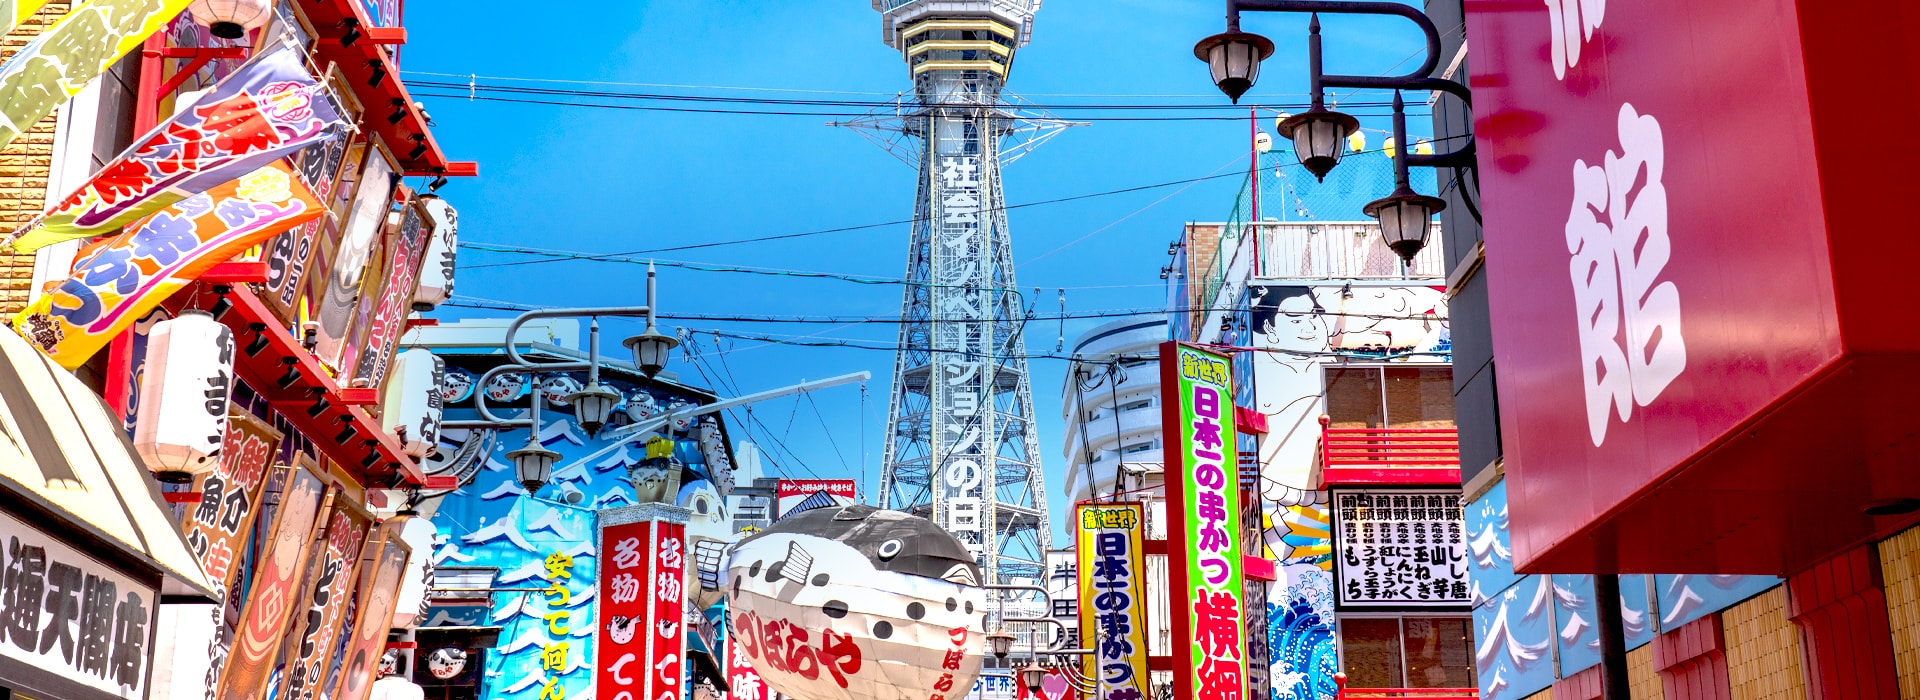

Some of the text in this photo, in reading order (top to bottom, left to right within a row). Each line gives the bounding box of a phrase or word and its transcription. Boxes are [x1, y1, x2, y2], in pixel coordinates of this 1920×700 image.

[1182, 352, 1228, 388] 新世界
[1192, 385, 1230, 584] 日本一の串かつ
[1341, 494, 1357, 521] 前頭
[1376, 494, 1392, 521] 前頭
[1393, 494, 1409, 521] 前頭
[1410, 494, 1426, 521] 前頭
[1427, 494, 1443, 521] 前頭
[1444, 494, 1460, 521] 前頭
[1083, 509, 1137, 530] 新世界
[611, 537, 641, 605] 名物
[656, 537, 683, 604] 名物
[1344, 545, 1361, 599] もち
[1362, 545, 1380, 599] うずら玉子
[1379, 545, 1398, 599] 紅しょうが
[1396, 545, 1413, 599] にんにく
[1413, 545, 1432, 599] 玉ねぎ
[1431, 545, 1449, 599] 山芋
[1448, 545, 1467, 599] しし唐
[0, 535, 148, 692] 通天閣店
[539, 550, 574, 700] 安うて何ん
[1050, 560, 1078, 650] 半田屋
[1093, 533, 1133, 684] 日本一の串かつ
[736, 609, 862, 689] づぼらや
